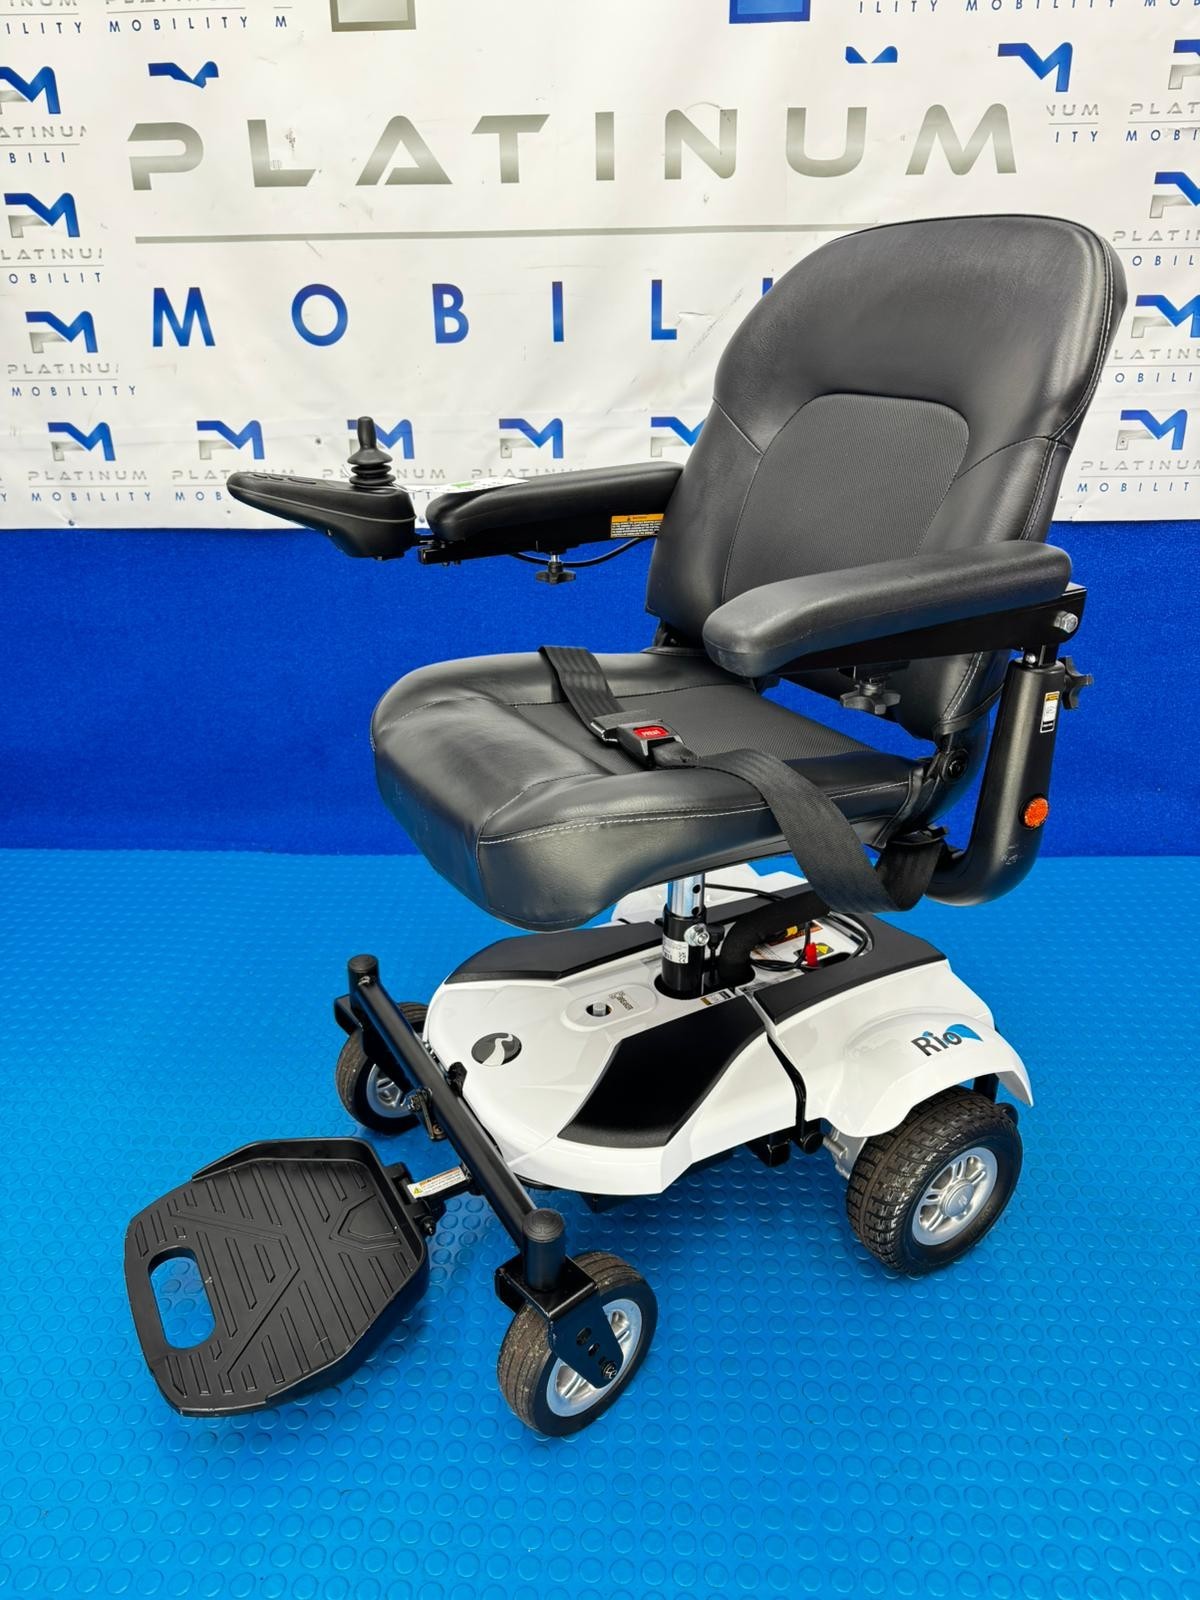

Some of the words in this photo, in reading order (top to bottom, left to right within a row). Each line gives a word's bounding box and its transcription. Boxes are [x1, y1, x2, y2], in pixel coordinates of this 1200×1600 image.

[109, 16, 247, 33] MOBILITY
[127, 103, 1017, 191] PLATINUM
[11, 385, 136, 397] MOBILITY
[28, 470, 148, 481] PLATINUM
[31, 491, 151, 502] MOBILITY
[910, 1030, 963, 1057] Rio
